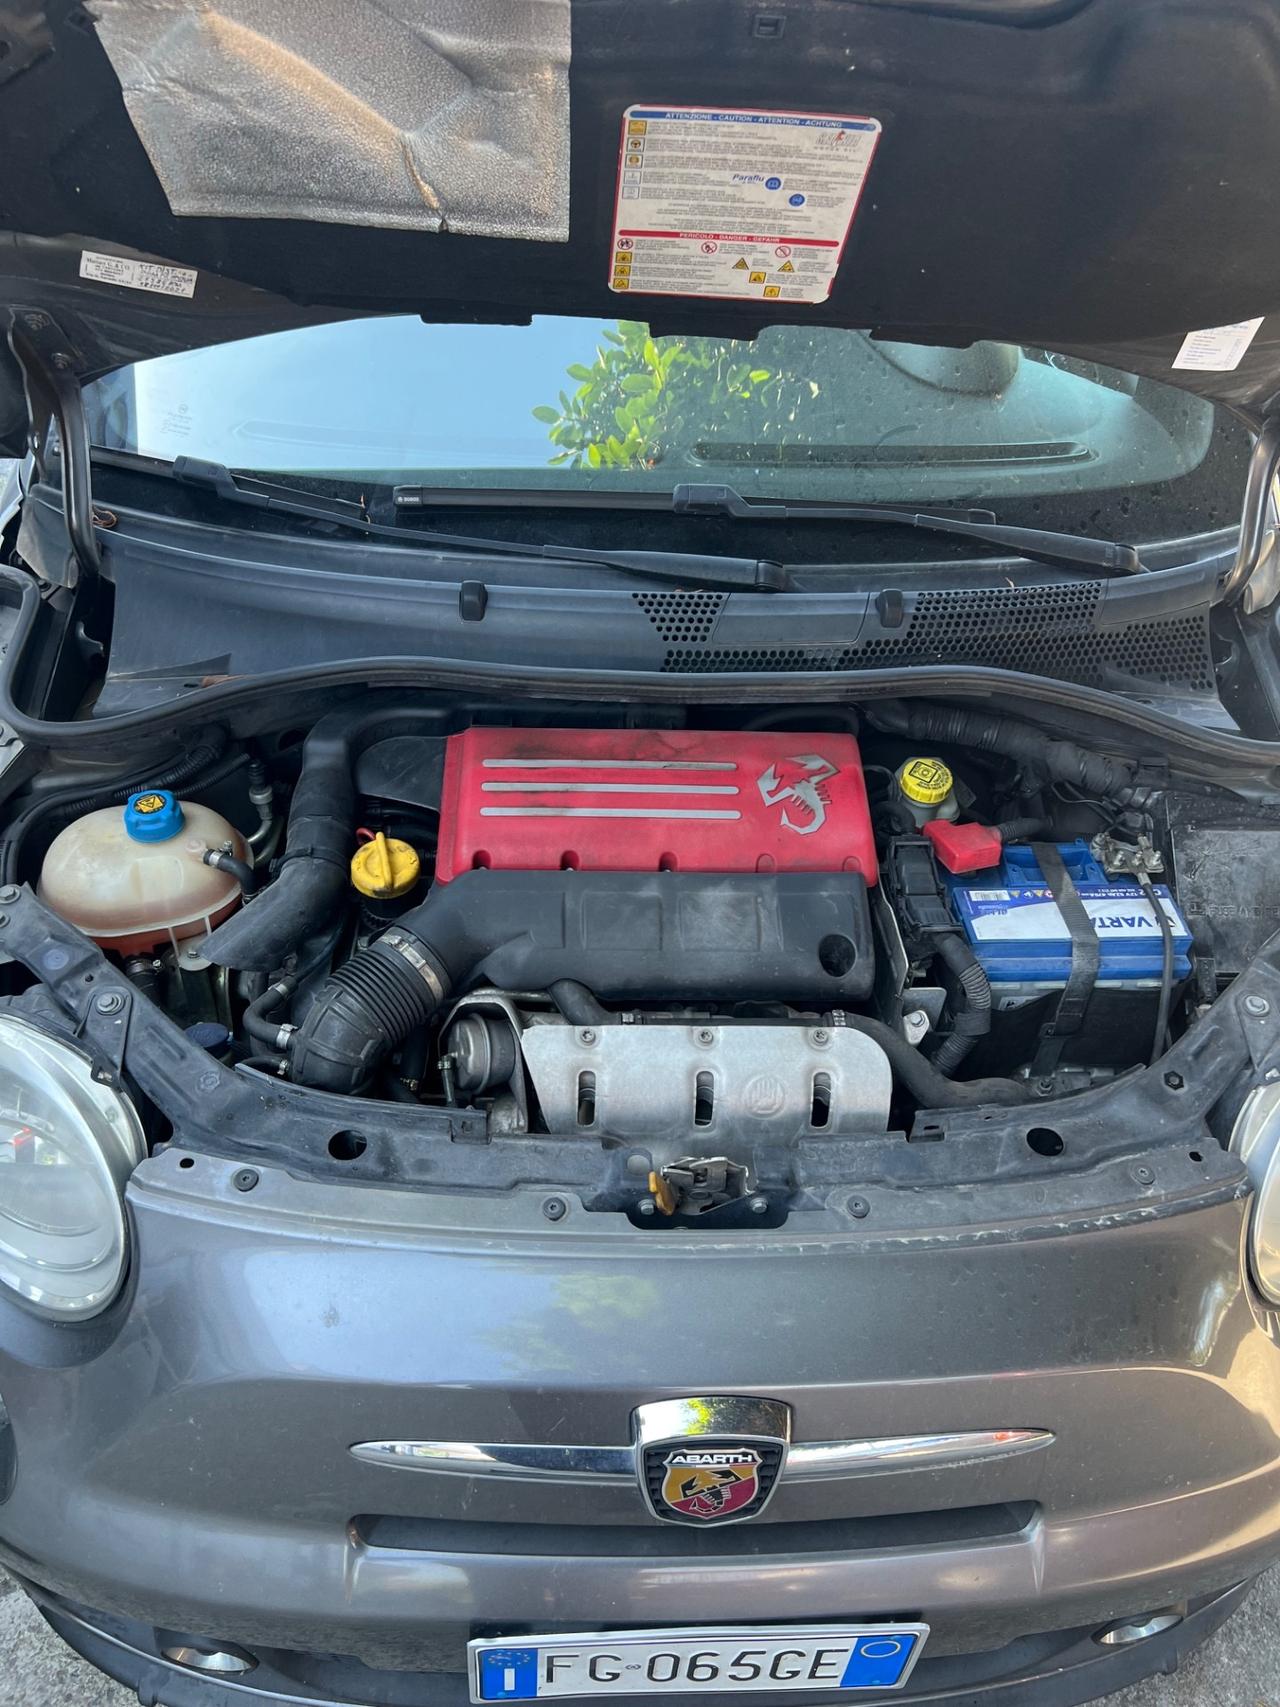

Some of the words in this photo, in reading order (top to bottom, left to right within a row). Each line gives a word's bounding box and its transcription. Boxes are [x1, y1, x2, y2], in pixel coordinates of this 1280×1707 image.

[665, 112, 712, 120] ATTENZIONE
[719, 114, 753, 122] CAUTION
[758, 116, 800, 125] ATTENTION
[805, 120, 842, 128] ACHTUNG
[733, 173, 764, 182] Paraflu
[671, 1454, 752, 1464] ABARTH
